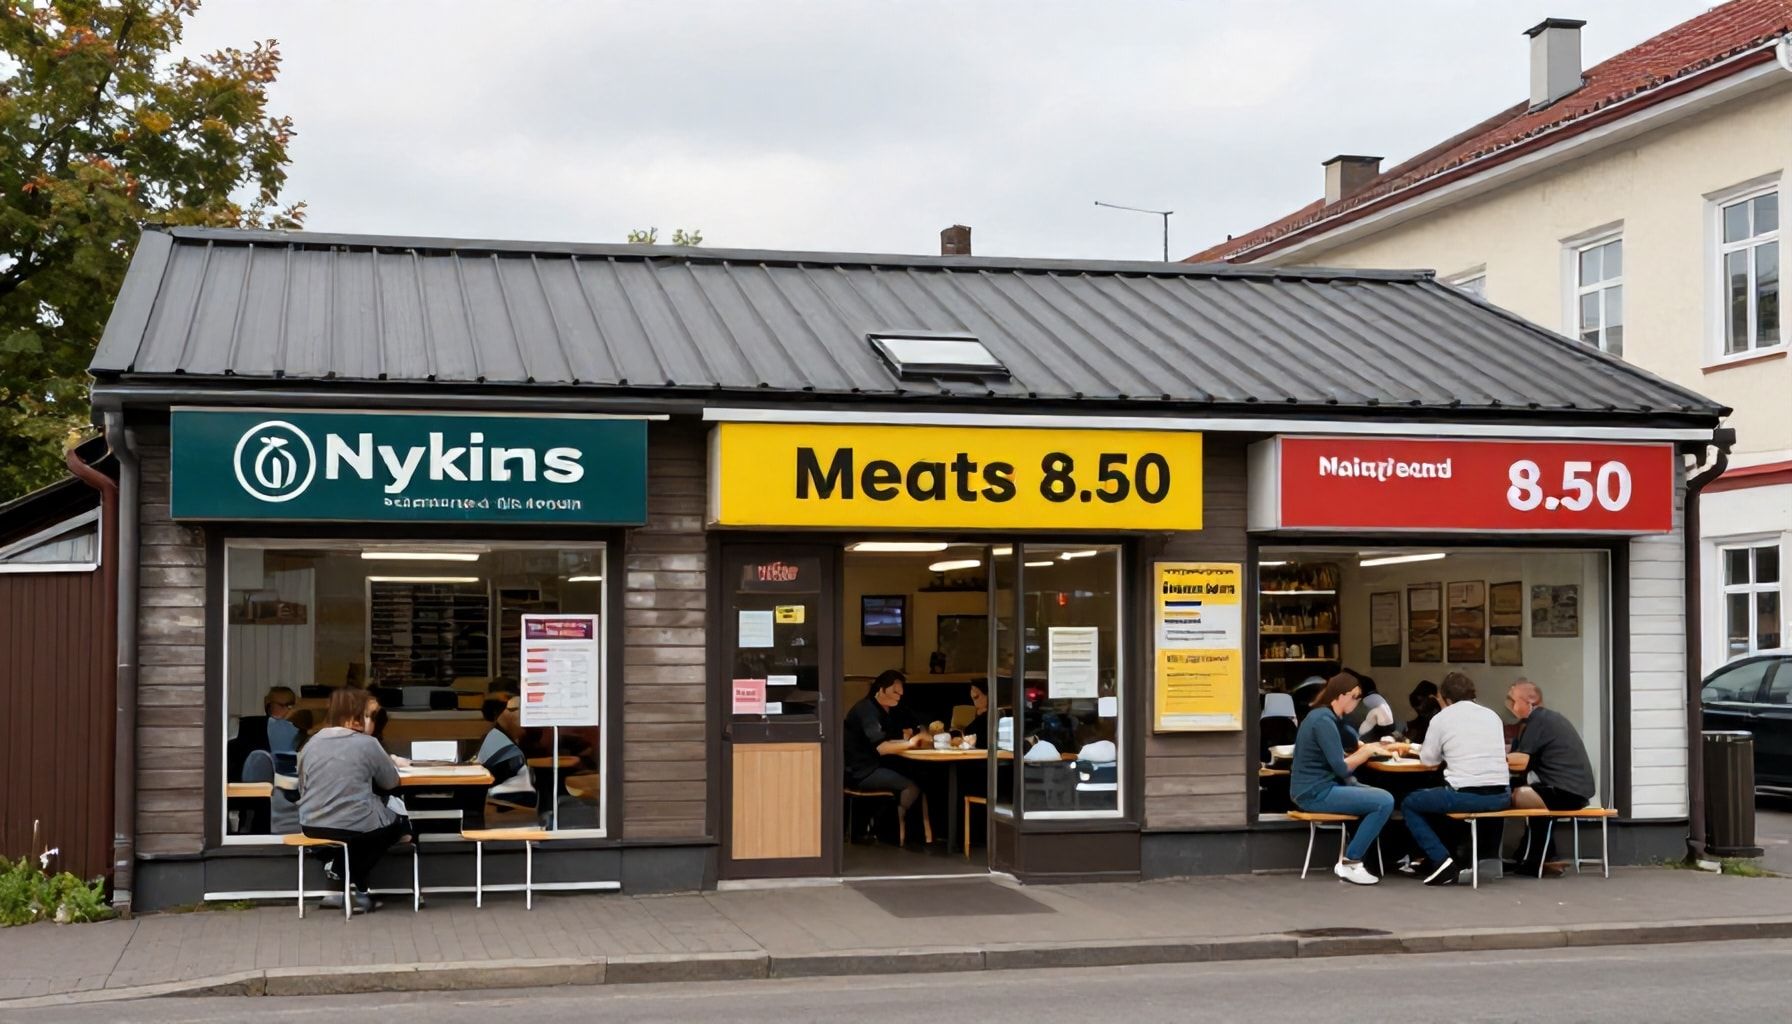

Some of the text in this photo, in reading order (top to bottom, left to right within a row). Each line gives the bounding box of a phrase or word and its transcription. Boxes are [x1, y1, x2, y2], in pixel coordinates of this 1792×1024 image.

[325, 431, 585, 494] Nykins
[796, 447, 1171, 504] Meats 8.50
[1506, 459, 1632, 512] 8.50
